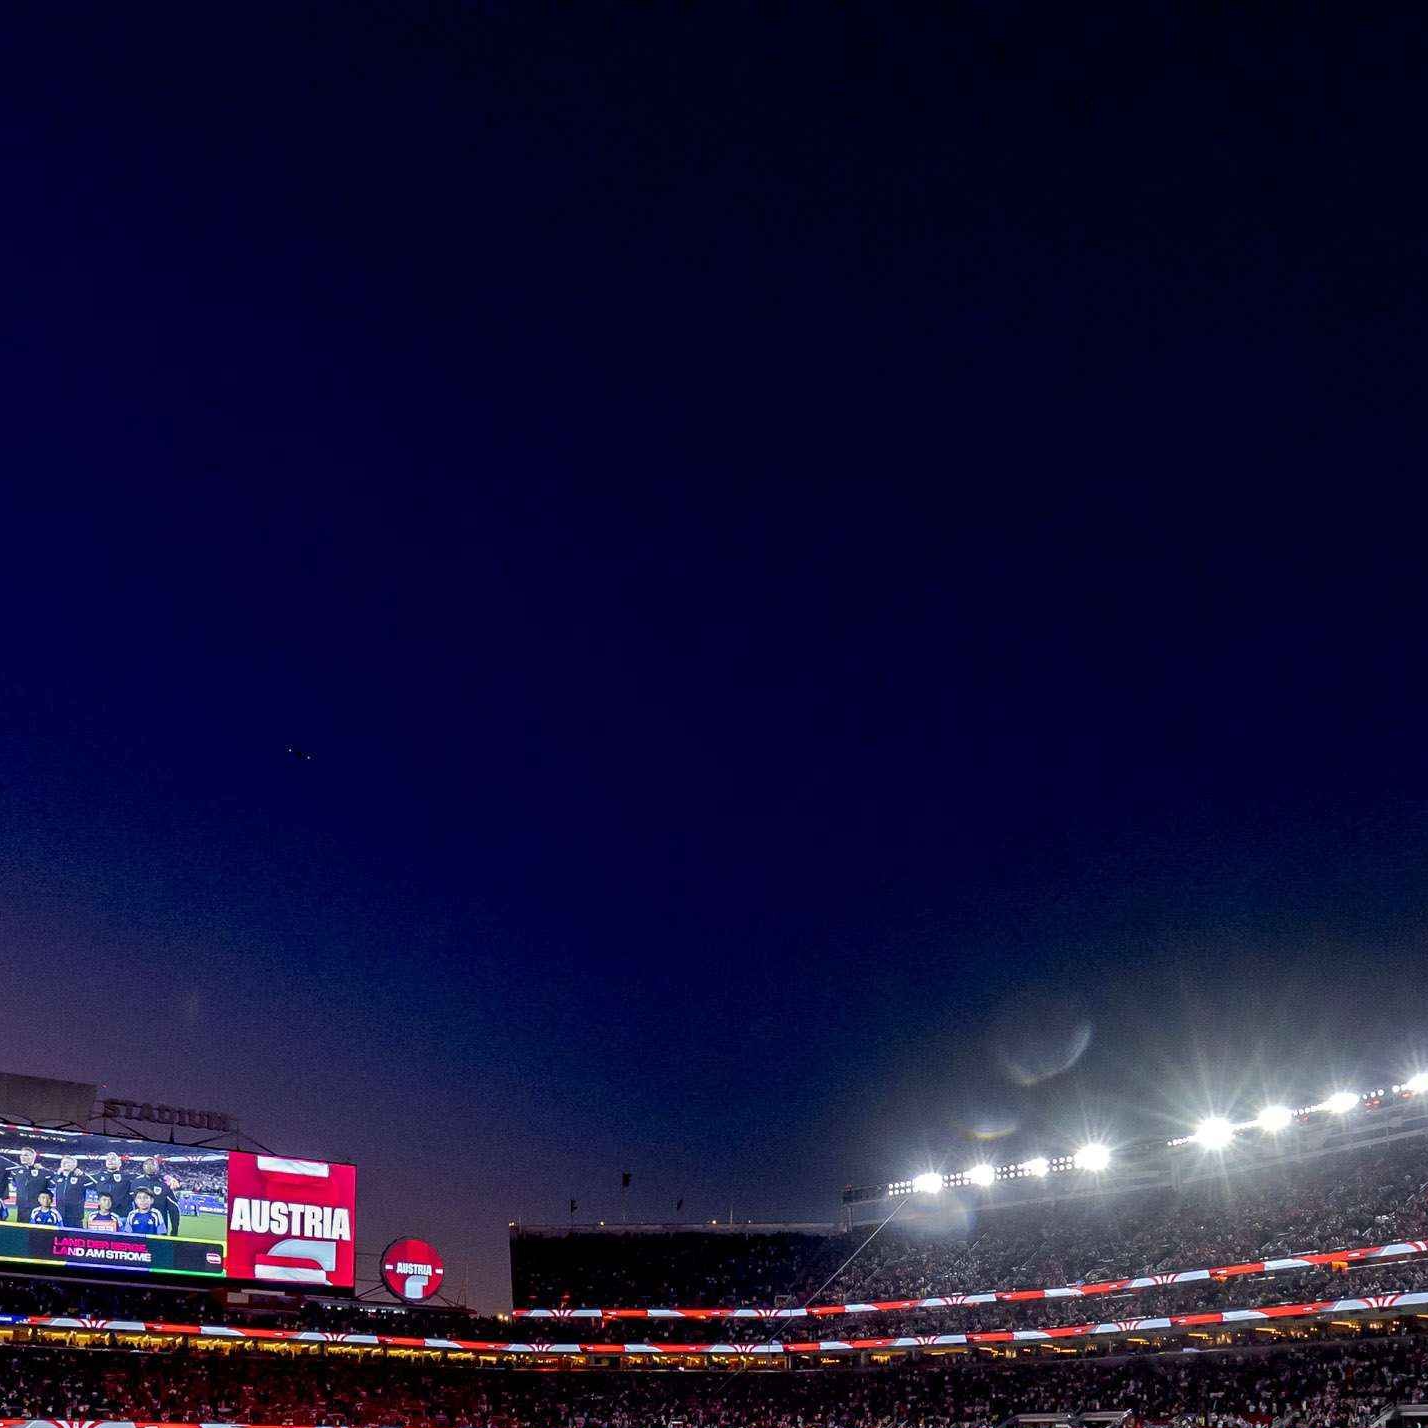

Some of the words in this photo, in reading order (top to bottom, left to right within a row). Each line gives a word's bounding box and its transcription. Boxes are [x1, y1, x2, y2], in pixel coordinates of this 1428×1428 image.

[103, 1099, 230, 1131] STADIUM
[229, 1197, 351, 1240] AUSTRIA
[53, 1245, 84, 1257] LAND
[85, 1247, 105, 1259] AM
[106, 1249, 152, 1262] STROME
[396, 1262, 432, 1276] AUSTRIA
